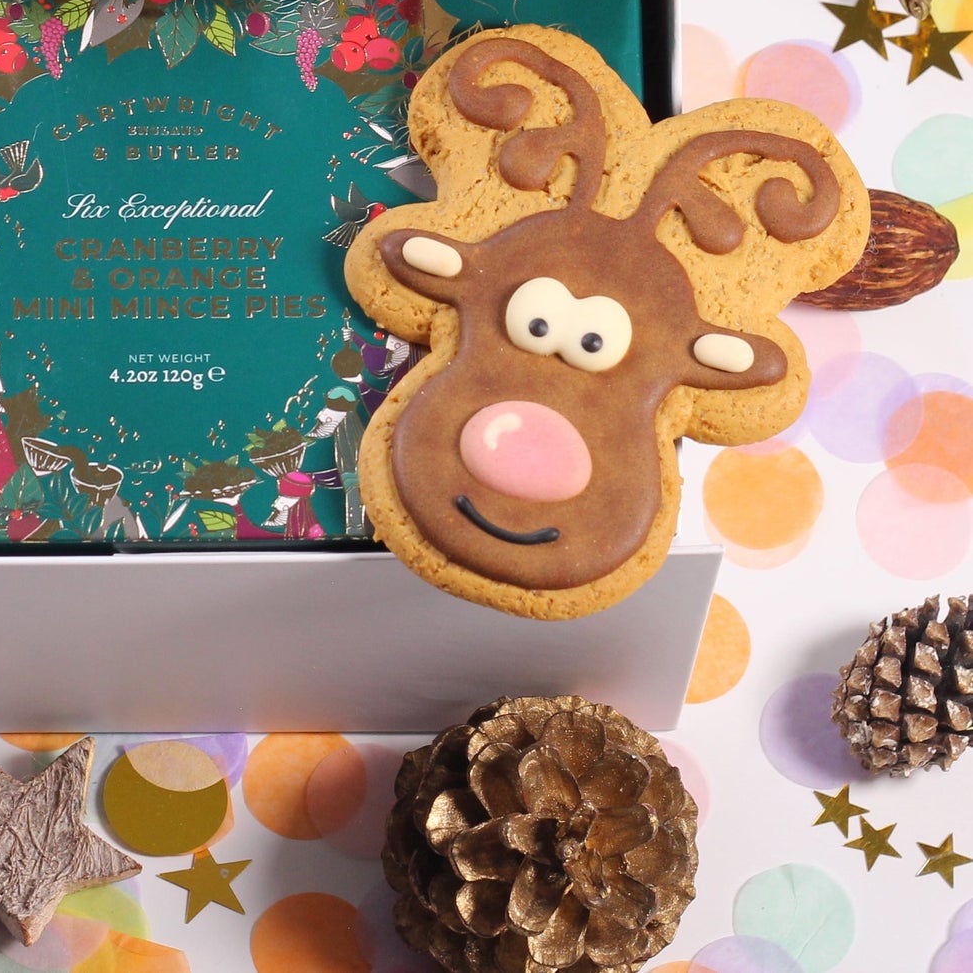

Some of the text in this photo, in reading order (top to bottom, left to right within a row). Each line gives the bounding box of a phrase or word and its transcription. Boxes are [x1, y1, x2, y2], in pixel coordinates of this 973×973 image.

[52, 95, 283, 141] CARTWRIGHT
[92, 145, 240, 161] & BUTLER
[62, 189, 274, 230] Six Exceptional
[55, 237, 284, 261] CRANBERRY
[71, 266, 267, 290] & ORANGE
[13, 295, 327, 320] MINI MINCE PIES
[128, 353, 211, 363] NET WEIGHT
[109, 369, 158, 383] 4.2oz
[162, 369, 204, 390] 120g
